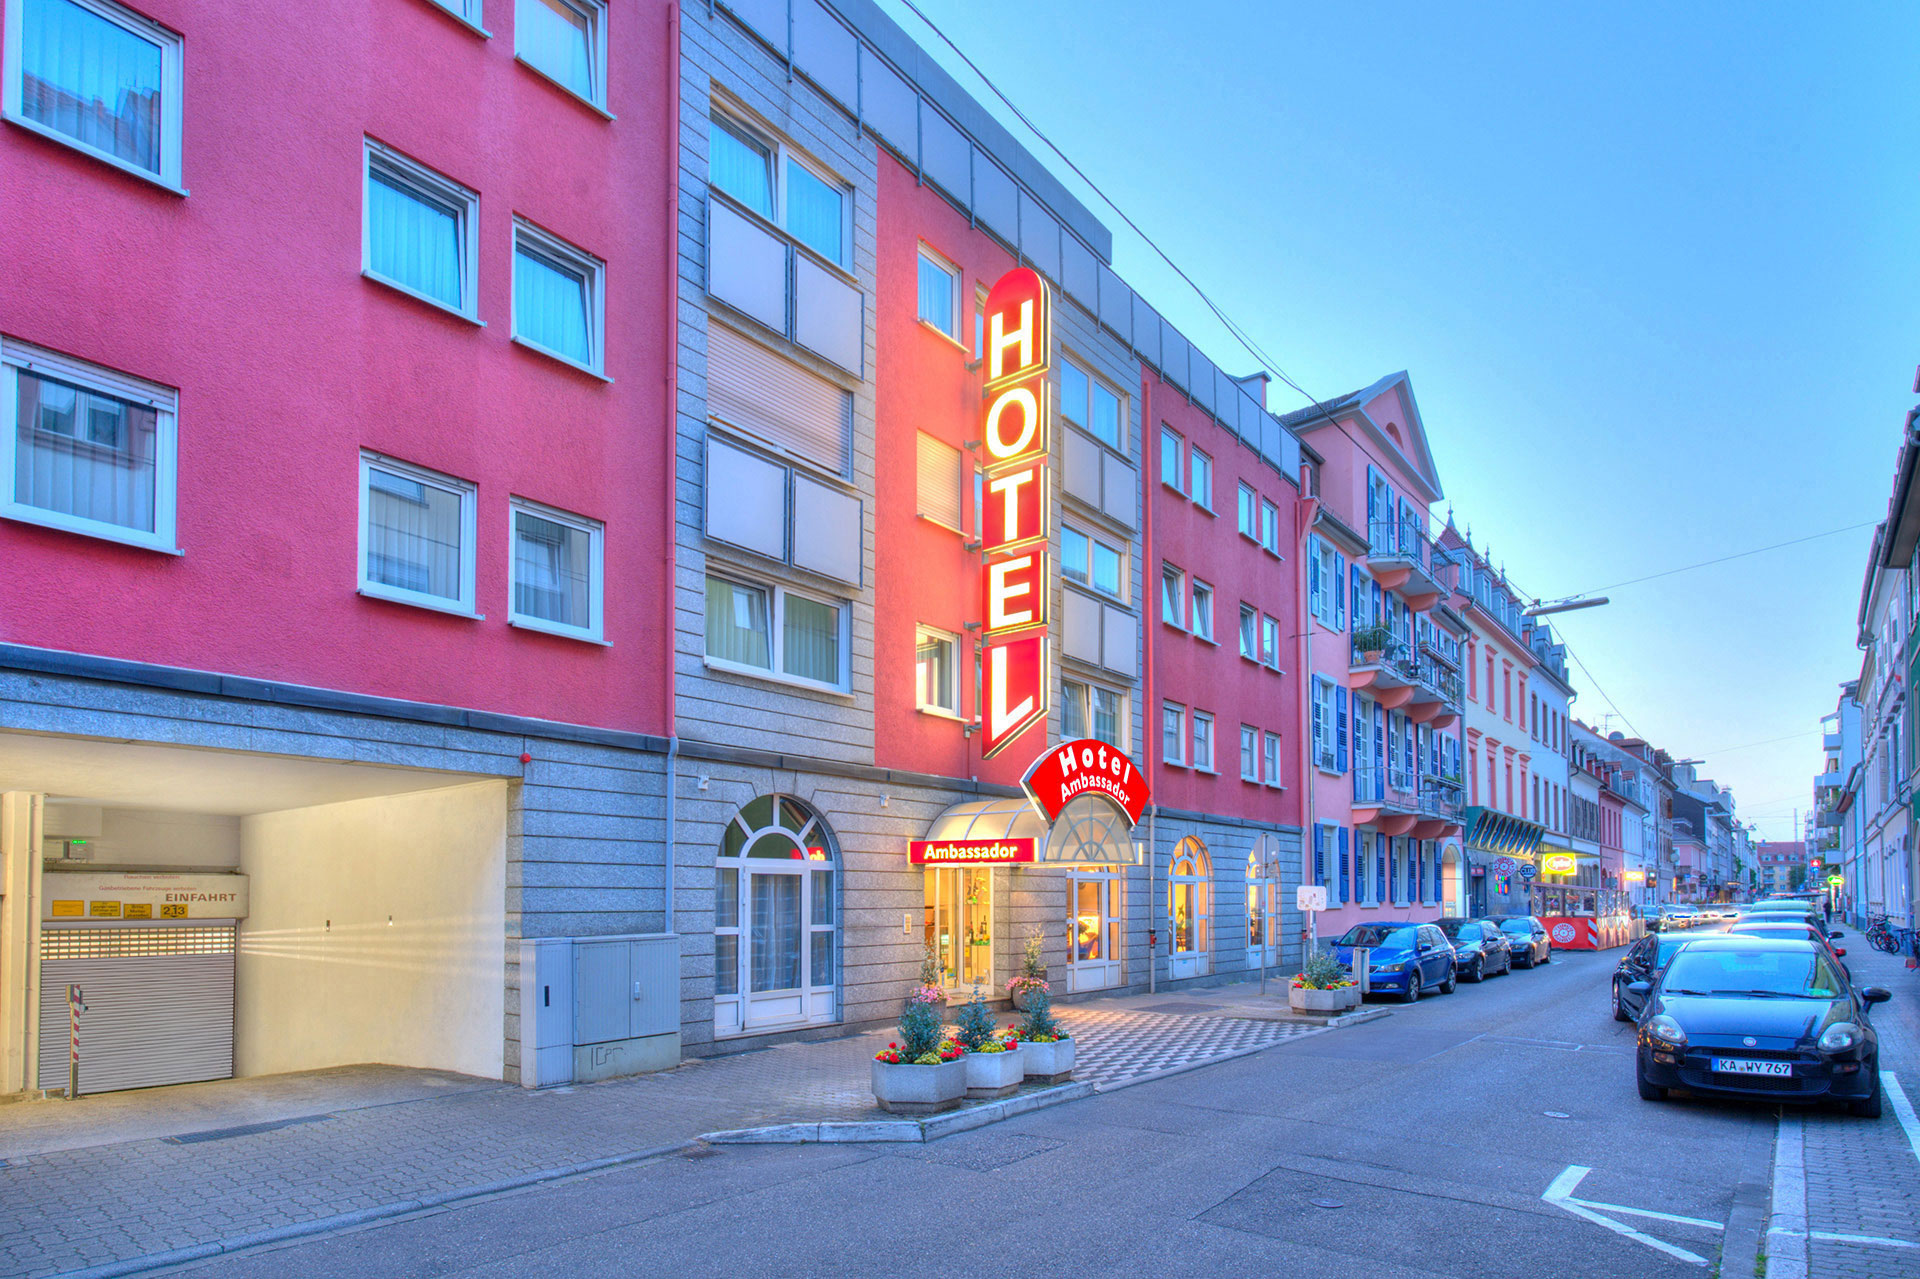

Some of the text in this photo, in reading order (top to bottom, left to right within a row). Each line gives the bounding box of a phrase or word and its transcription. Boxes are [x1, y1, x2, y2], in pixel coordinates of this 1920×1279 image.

[986, 298, 1038, 741] HOTEL
[1058, 745, 1132, 785] Hotel
[1060, 771, 1131, 806] Ambassador
[923, 843, 1018, 860] Ambassador
[165, 893, 237, 902] EINFAHRT
[1719, 1060, 1790, 1074] KA WY 767
